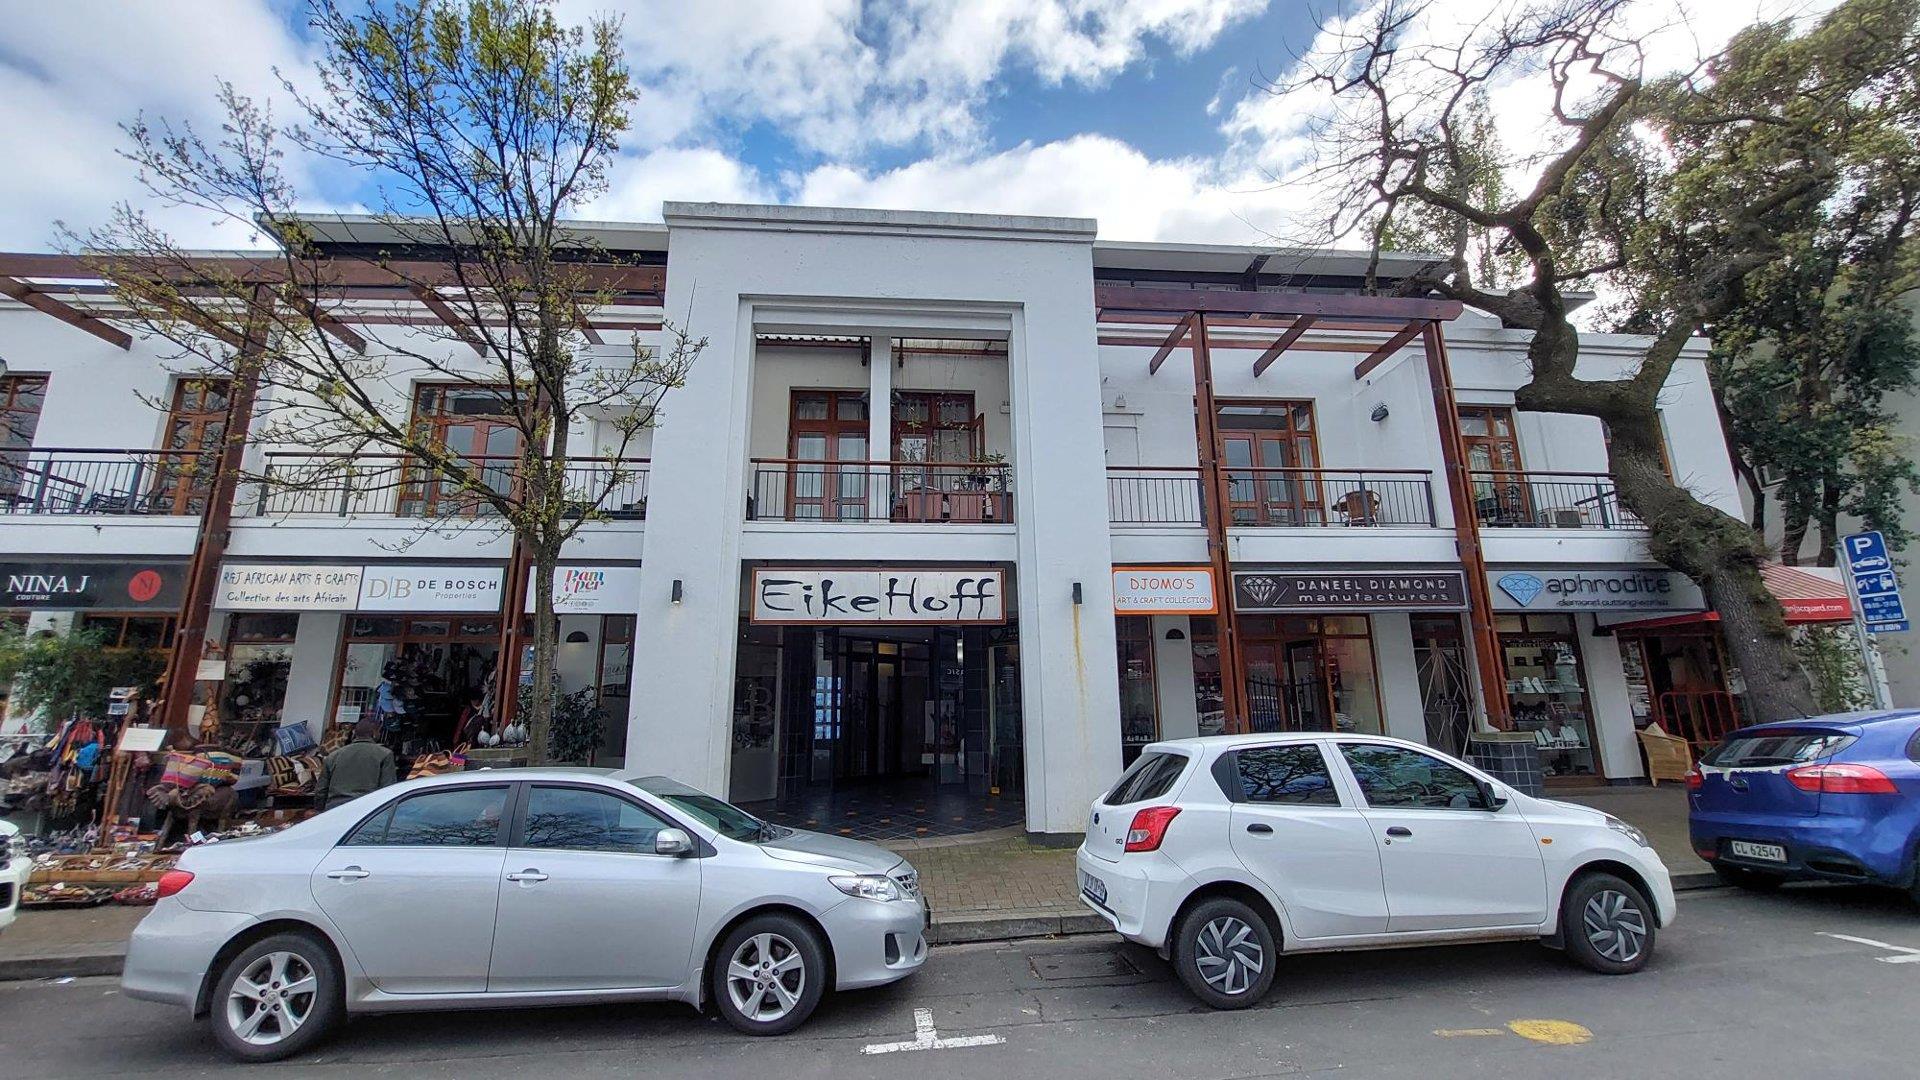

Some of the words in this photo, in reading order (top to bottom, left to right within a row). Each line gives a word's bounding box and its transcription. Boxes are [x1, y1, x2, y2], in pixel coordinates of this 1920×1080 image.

[1853, 537, 1873, 555] P
[6, 575, 69, 593] NINA
[76, 575, 90, 593] J
[244, 572, 287, 585] AFRICAN
[289, 572, 312, 585] ARTS
[325, 572, 359, 585] CRAFTS
[1130, 578, 1194, 590] DJOMO'S
[1297, 580, 1362, 590] DANEEL
[1370, 579, 1447, 590] DIAMOND
[417, 580, 437, 589] DE
[444, 580, 498, 590] BOSCH
[1546, 574, 1671, 596] aphrodite
[227, 591, 270, 602] Collection
[275, 592, 290, 602] des
[293, 593, 310, 602] arts
[435, 592, 477, 600] Properties
[761, 577, 995, 619] EikeHoff
[1299, 592, 1449, 602] manufacturers
[1735, 843, 1747, 855] CL
[1750, 845, 1781, 858] 62547
